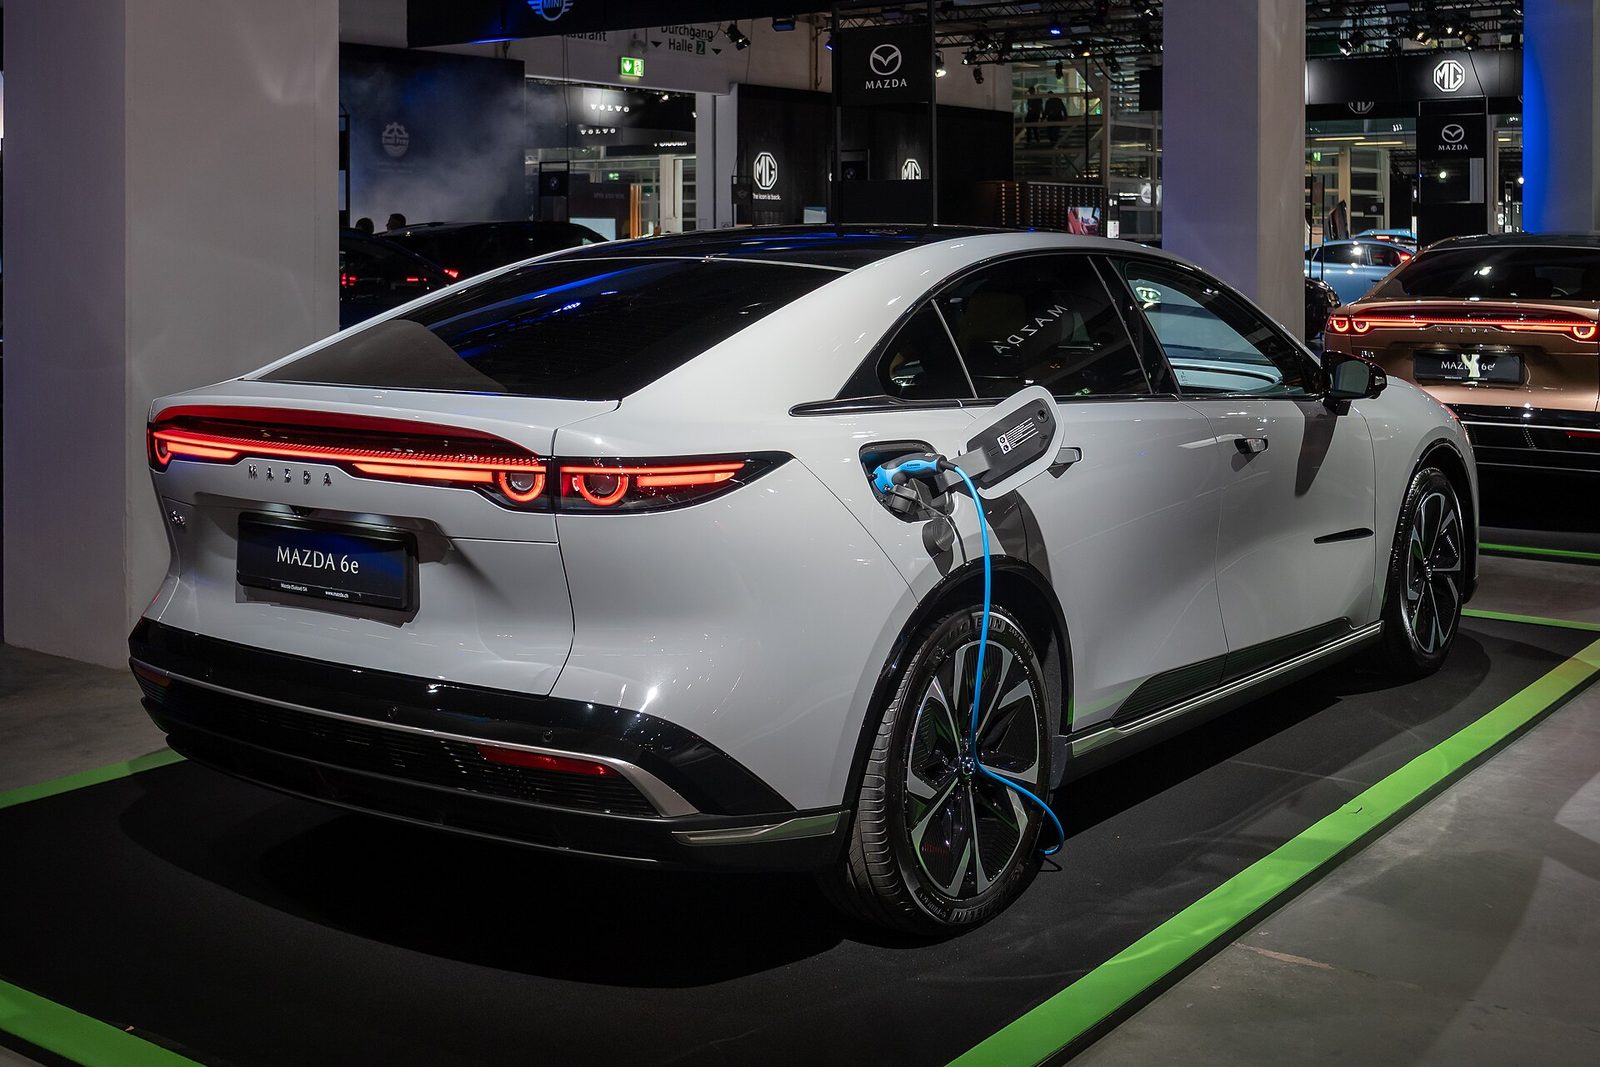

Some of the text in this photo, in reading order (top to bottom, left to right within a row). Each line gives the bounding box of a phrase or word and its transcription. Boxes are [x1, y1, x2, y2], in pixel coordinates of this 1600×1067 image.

[668, 38, 705, 54] Halle 2
[865, 78, 908, 90] MAZDA
[1435, 62, 1464, 90] MG
[590, 103, 630, 113] VOLVO
[755, 154, 776, 188] MG
[248, 464, 332, 487] MAZDA
[277, 545, 359, 574] MAZDA 6e
